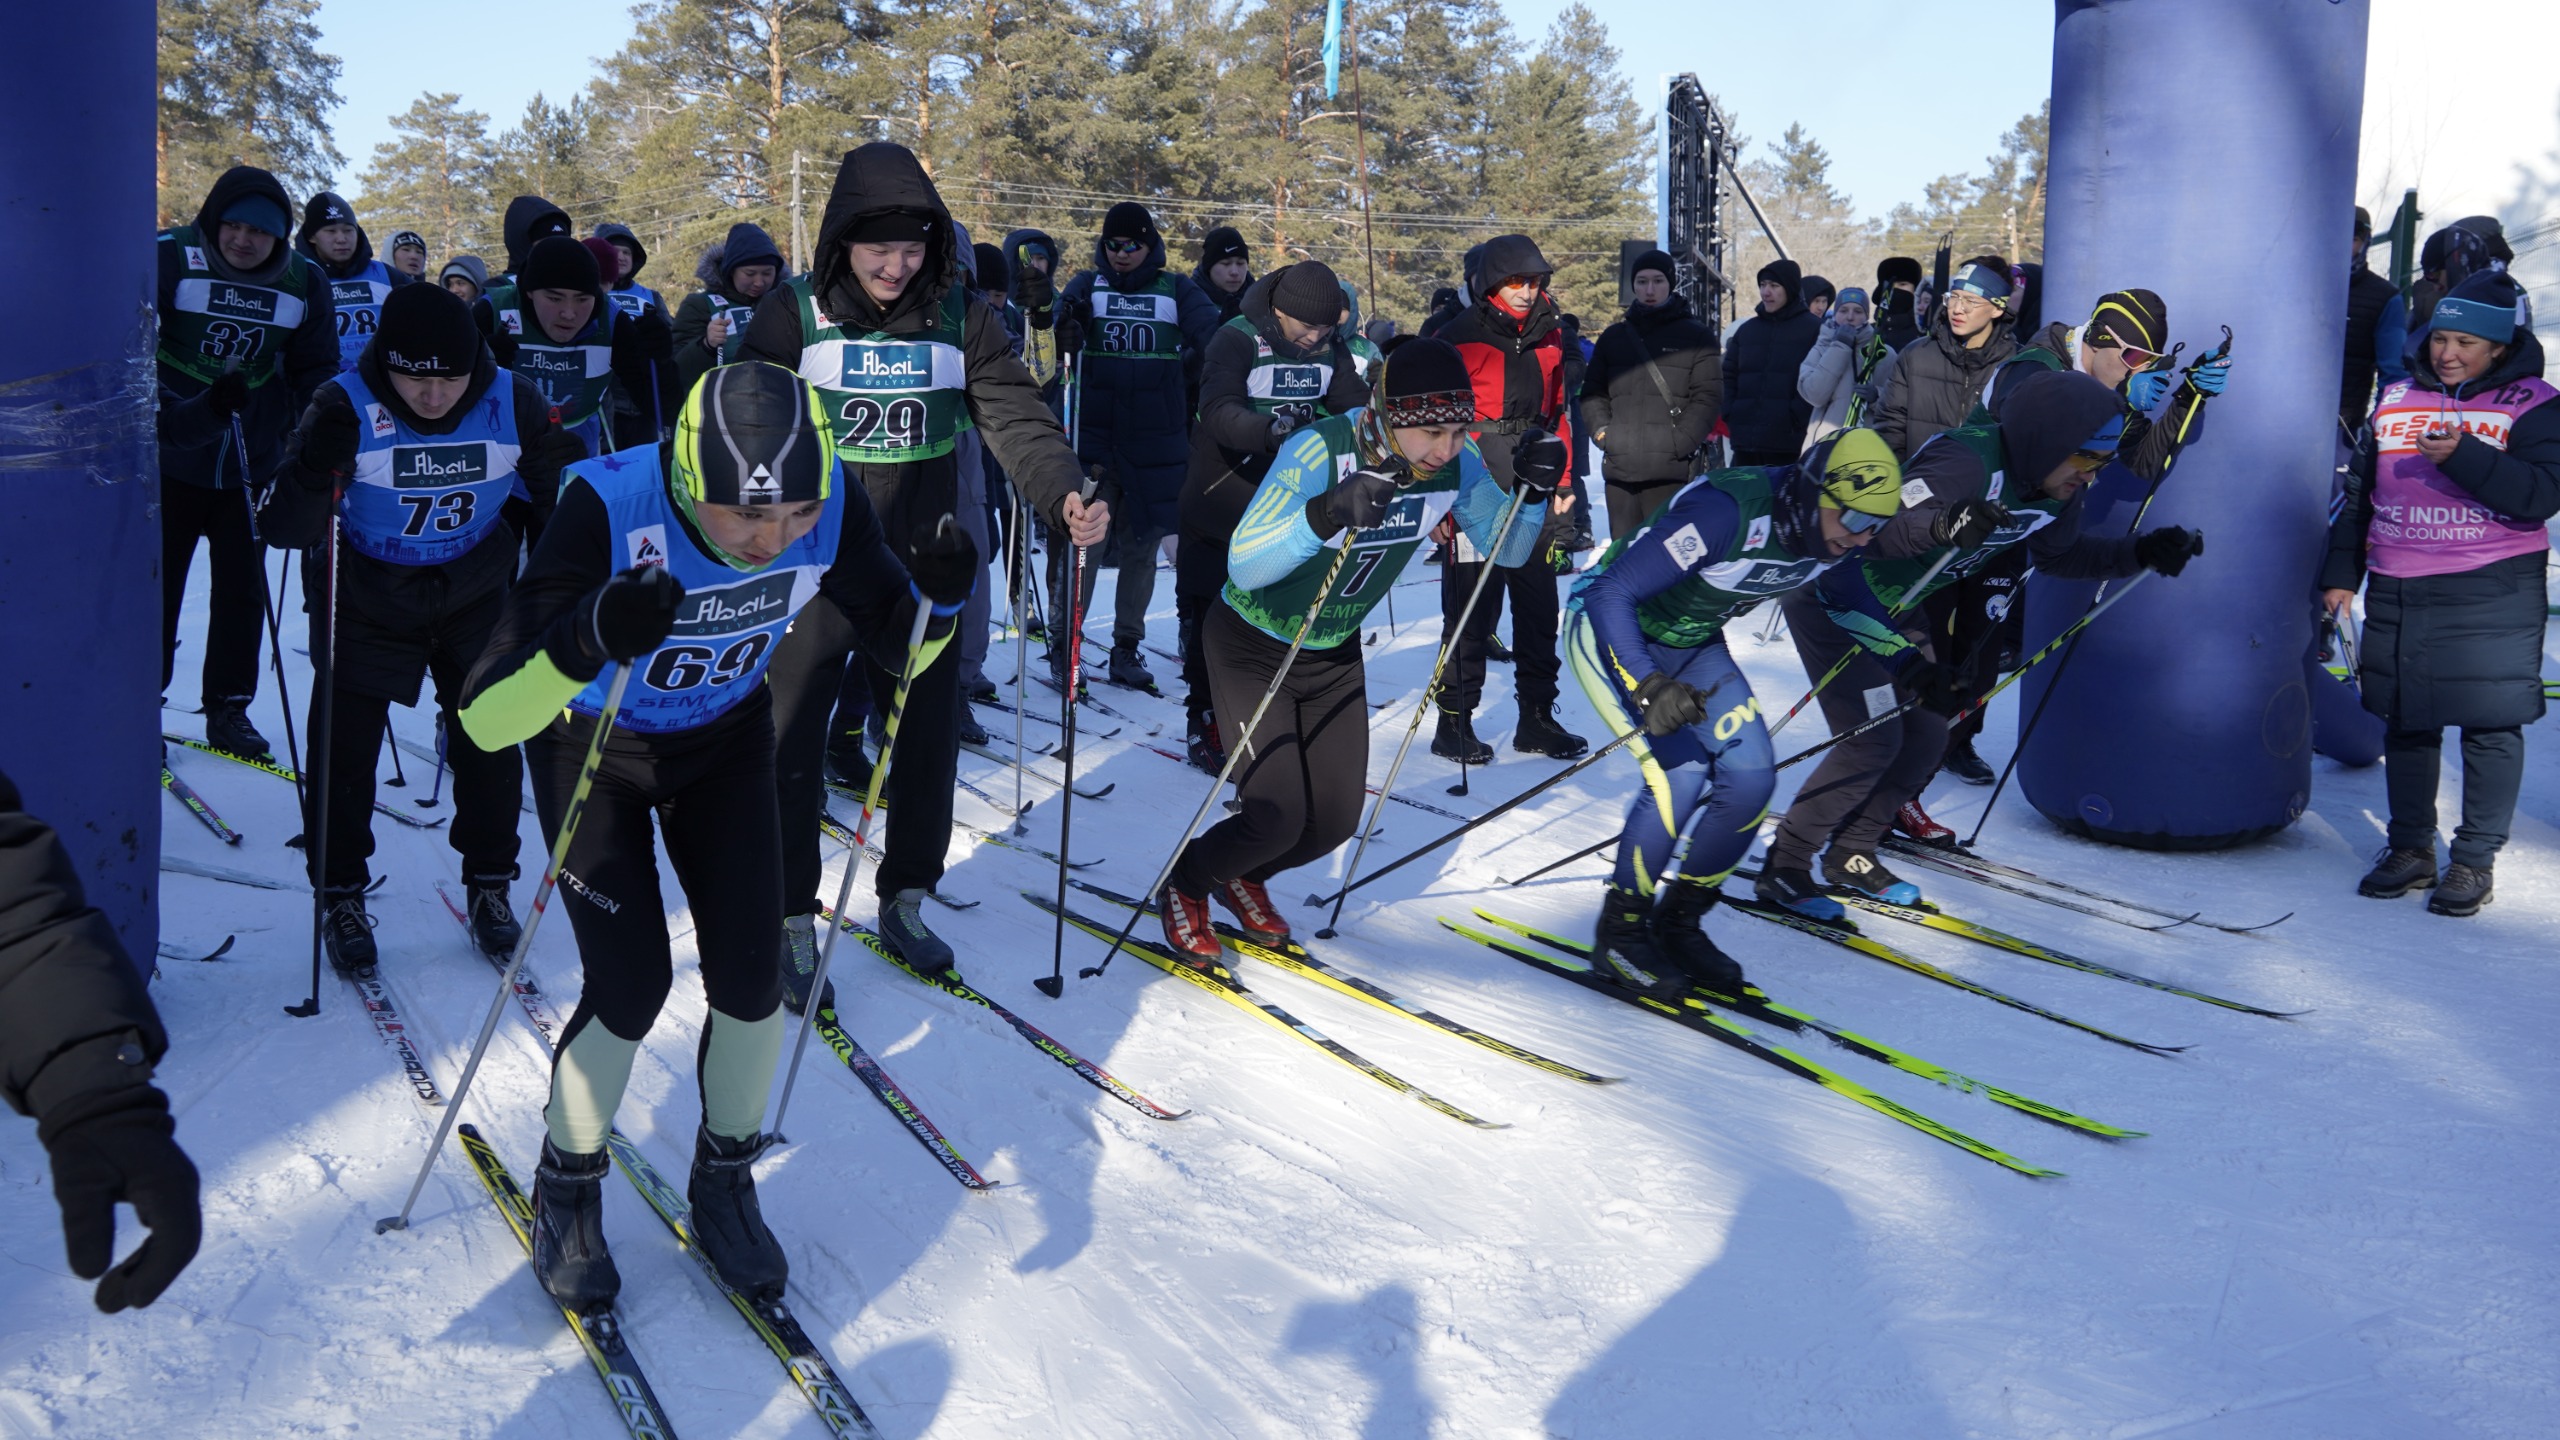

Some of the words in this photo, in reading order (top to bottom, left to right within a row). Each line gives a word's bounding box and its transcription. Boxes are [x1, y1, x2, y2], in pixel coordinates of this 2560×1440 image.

[1109, 297, 1153, 312] Abai
[200, 320, 266, 361] 31
[1102, 320, 1156, 352] 30
[387, 350, 450, 372] Abai
[520, 352, 580, 371] Abai
[847, 350, 927, 376] Abai
[865, 378, 915, 386] OBLYSY
[1275, 369, 1320, 388] Abai
[837, 397, 927, 449] 29
[399, 450, 482, 477] Abai
[1276, 471, 1301, 493] adidas
[399, 490, 477, 537] 73
[2405, 526, 2487, 540] COUNTRY
[1340, 548, 1388, 598] 7
[673, 587, 783, 624] Abai
[697, 614, 767, 634] OBLYSY
[643, 630, 773, 692] 69
[1848, 895, 1926, 925] FISCHER
[1778, 914, 1850, 944] FISCHER
[1243, 942, 1305, 972] FISCHER
[1171, 962, 1226, 998] FISCHER
